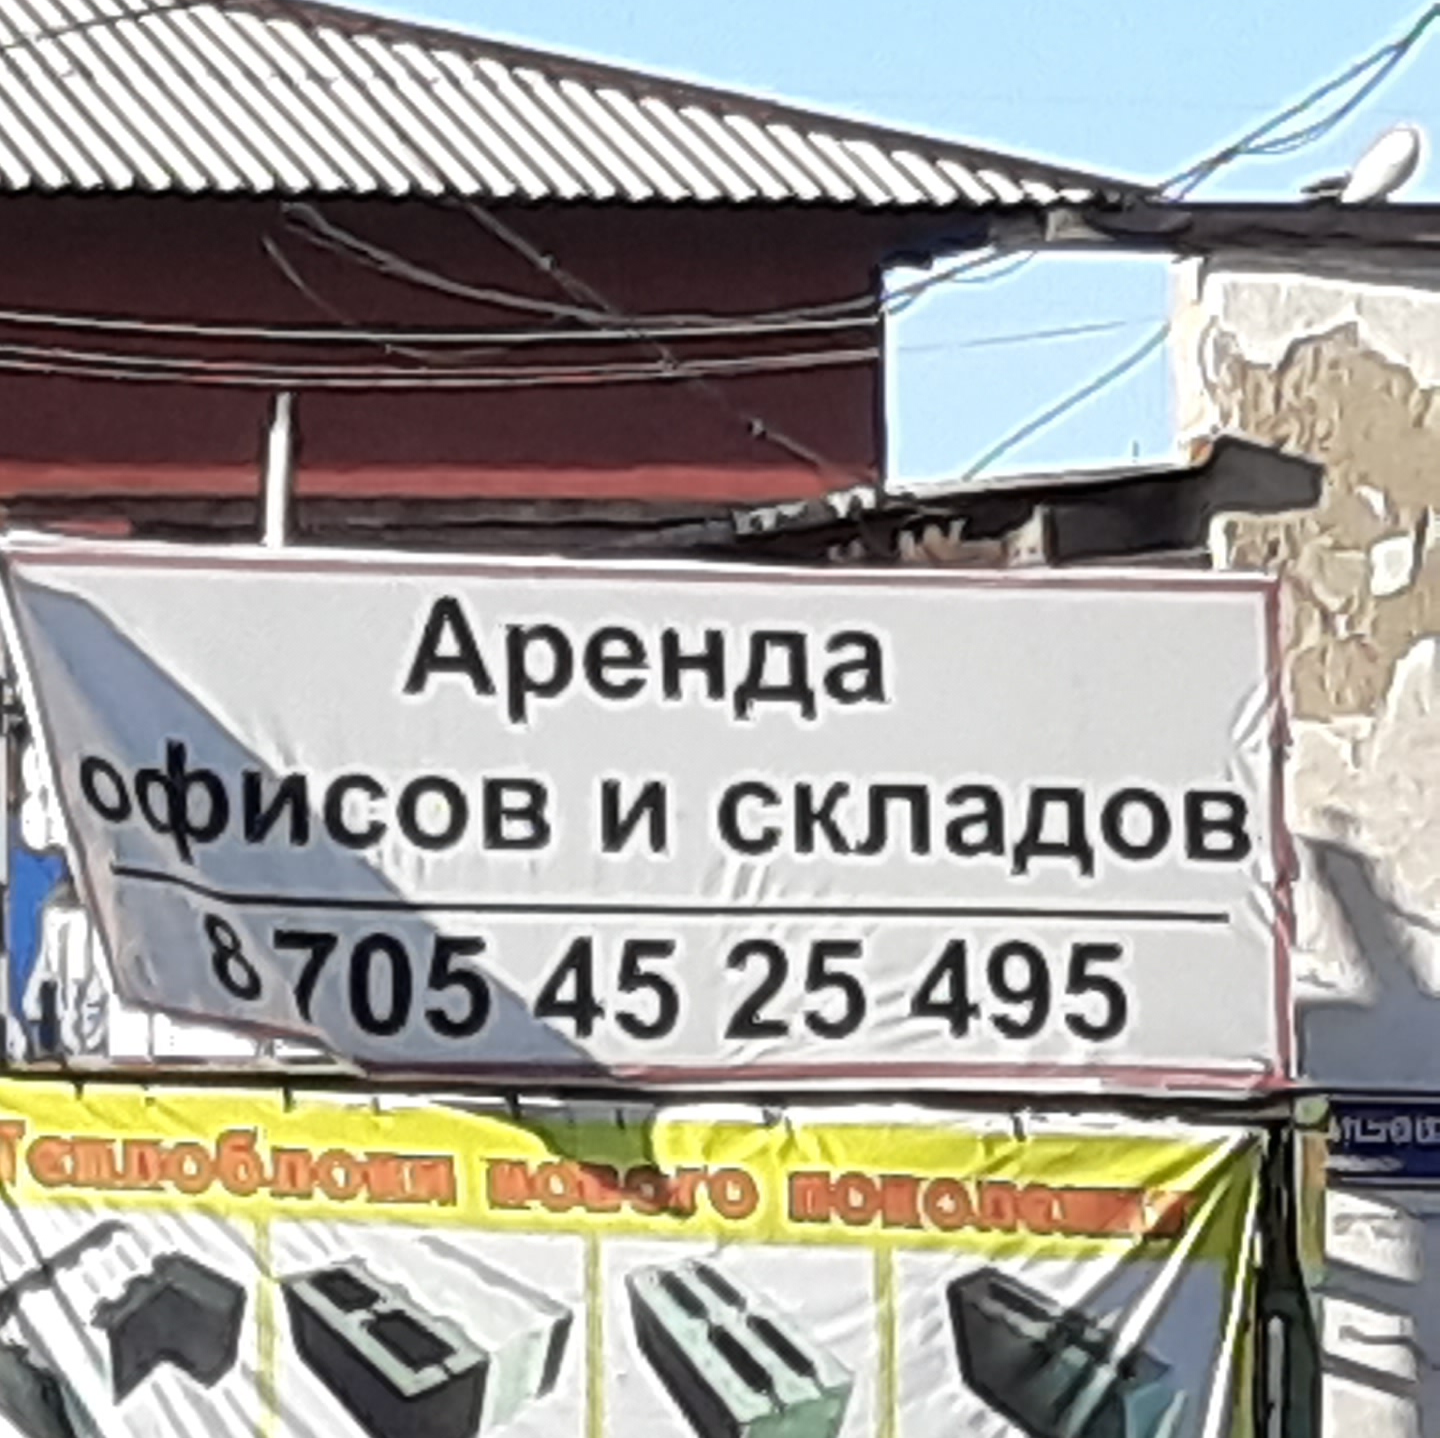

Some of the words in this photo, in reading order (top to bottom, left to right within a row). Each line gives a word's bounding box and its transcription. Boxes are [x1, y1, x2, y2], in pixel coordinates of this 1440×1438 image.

[402, 593, 890, 722] Аренда
[76, 738, 552, 865] офисов
[597, 775, 670, 854] и
[716, 776, 1253, 877] складов
[536, 935, 680, 1040] 45
[724, 937, 868, 1041] 25
[908, 937, 1132, 1044] 495
